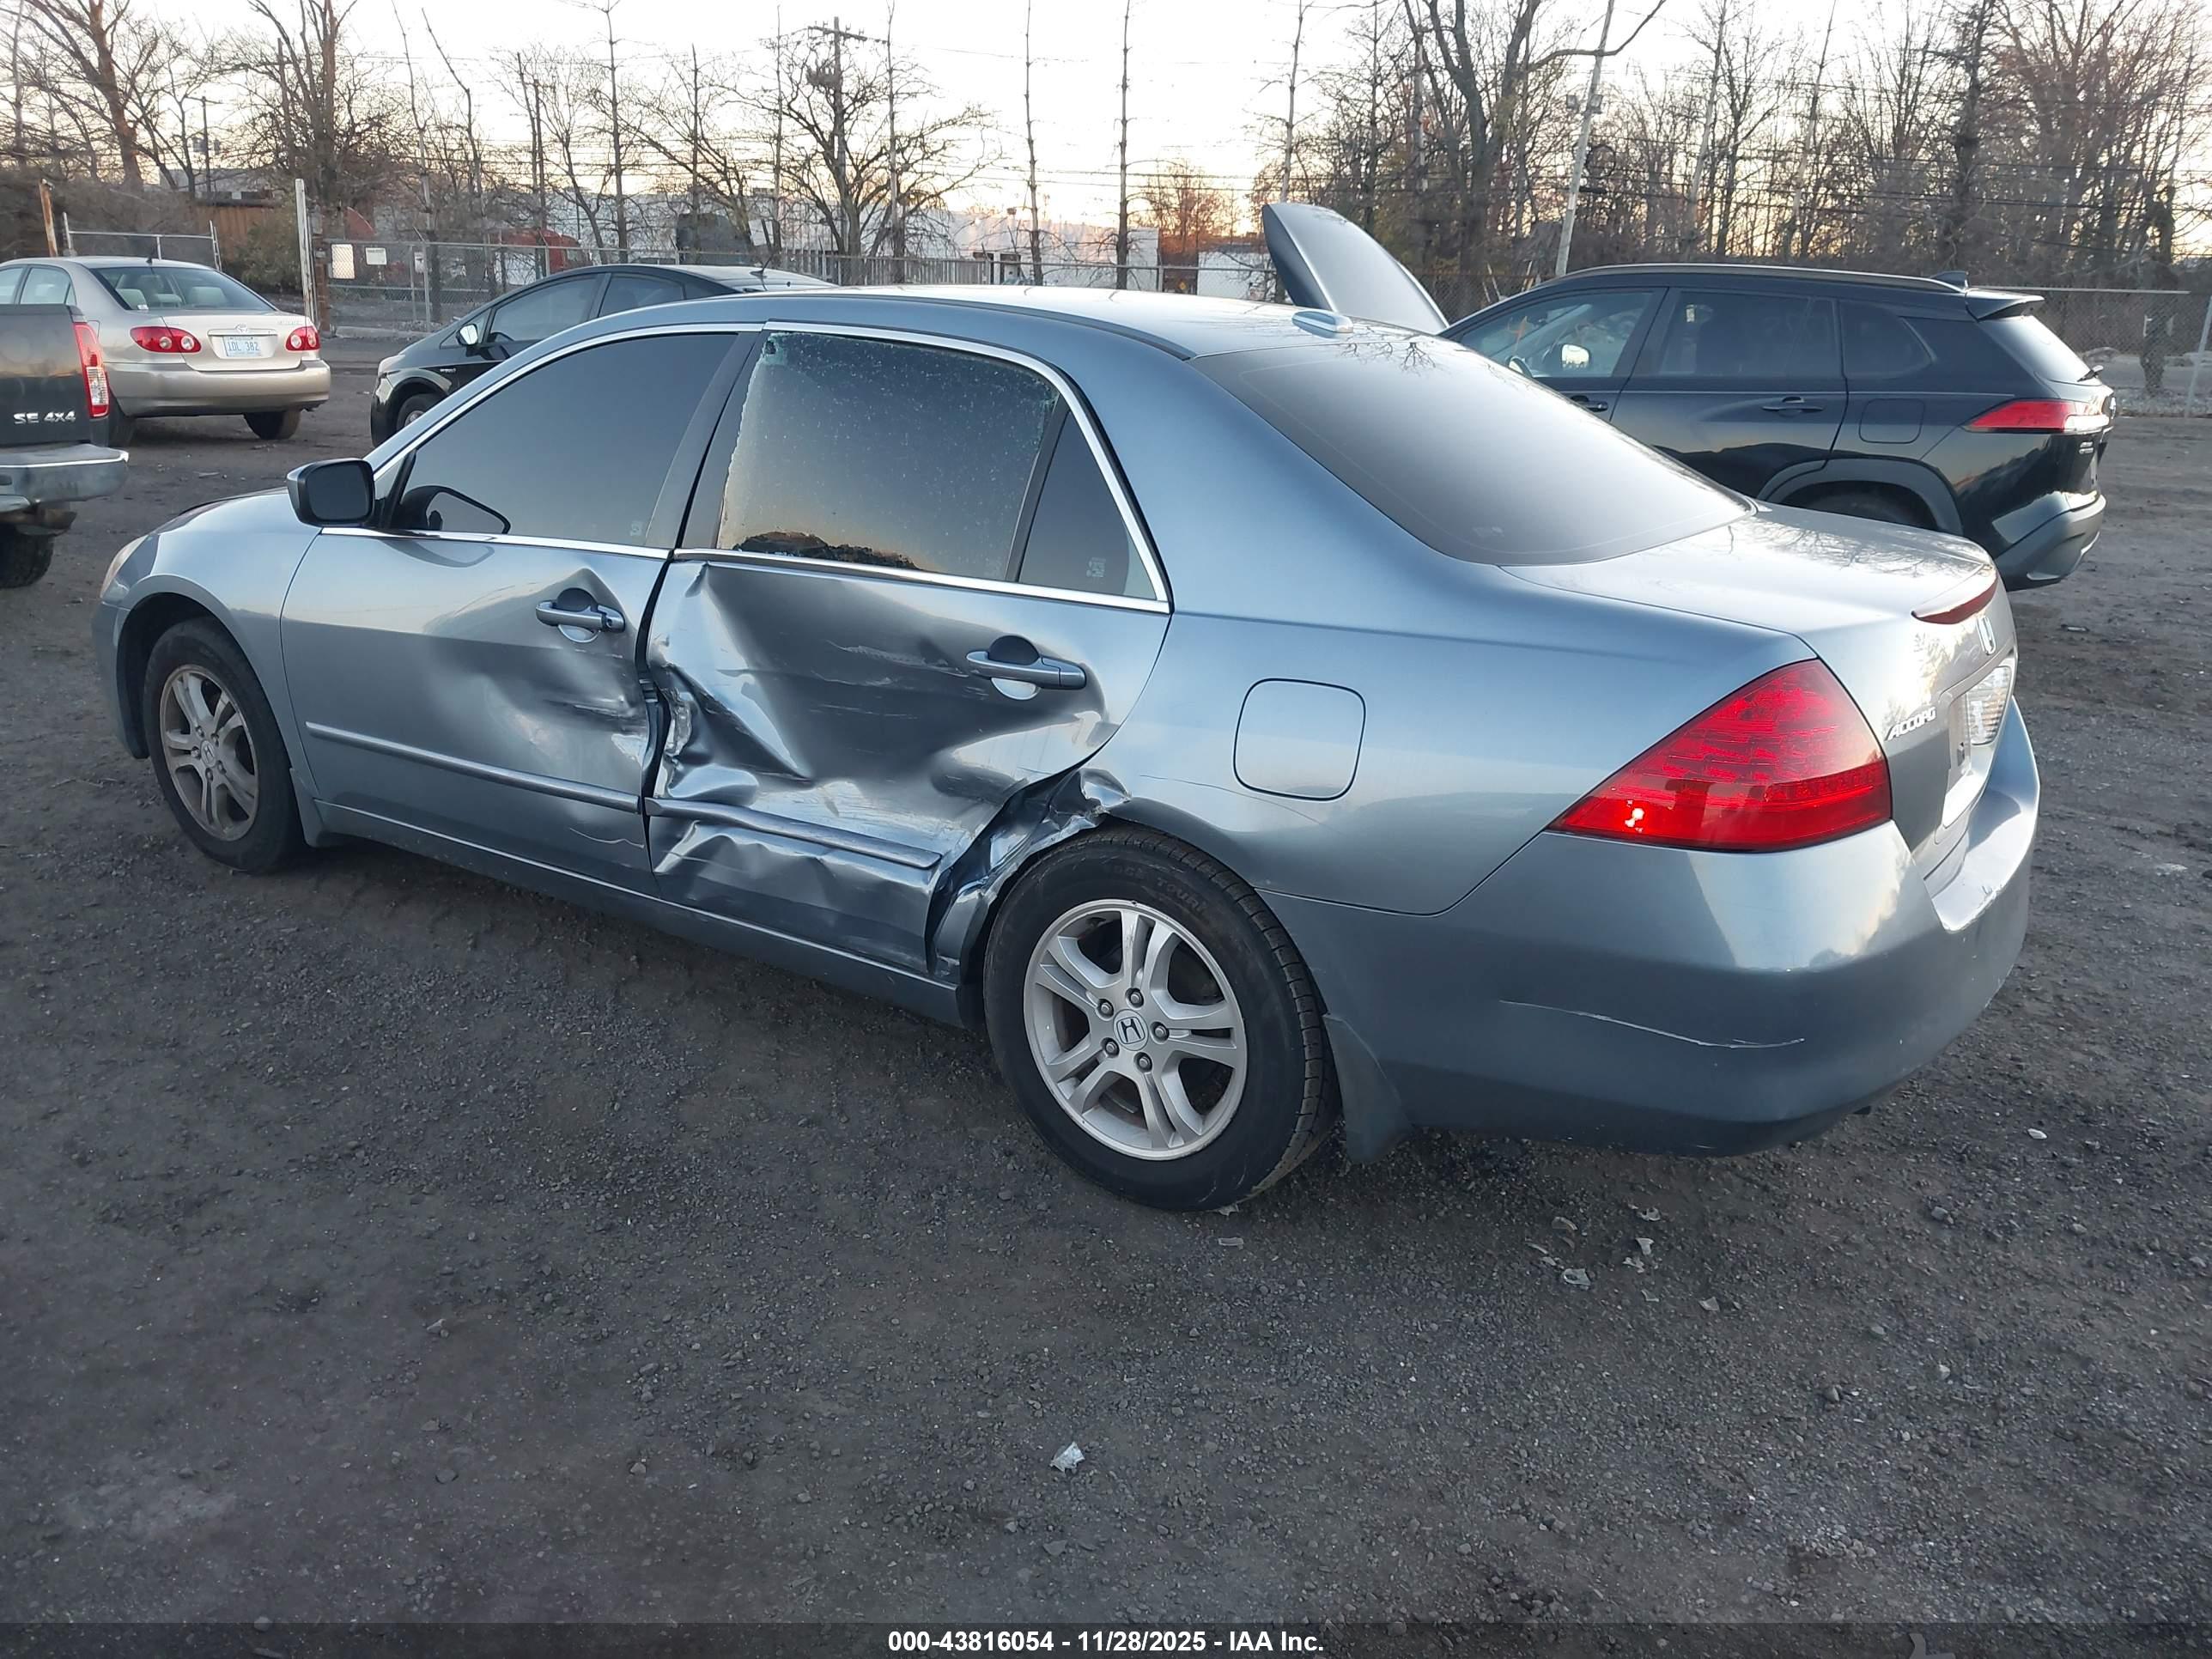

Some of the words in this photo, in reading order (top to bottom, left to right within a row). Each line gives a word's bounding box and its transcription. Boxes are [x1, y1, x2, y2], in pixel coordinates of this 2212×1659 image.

[245, 341, 259, 351] 382
[13, 413, 40, 424] SE
[1885, 706, 1937, 741] ACCORD
